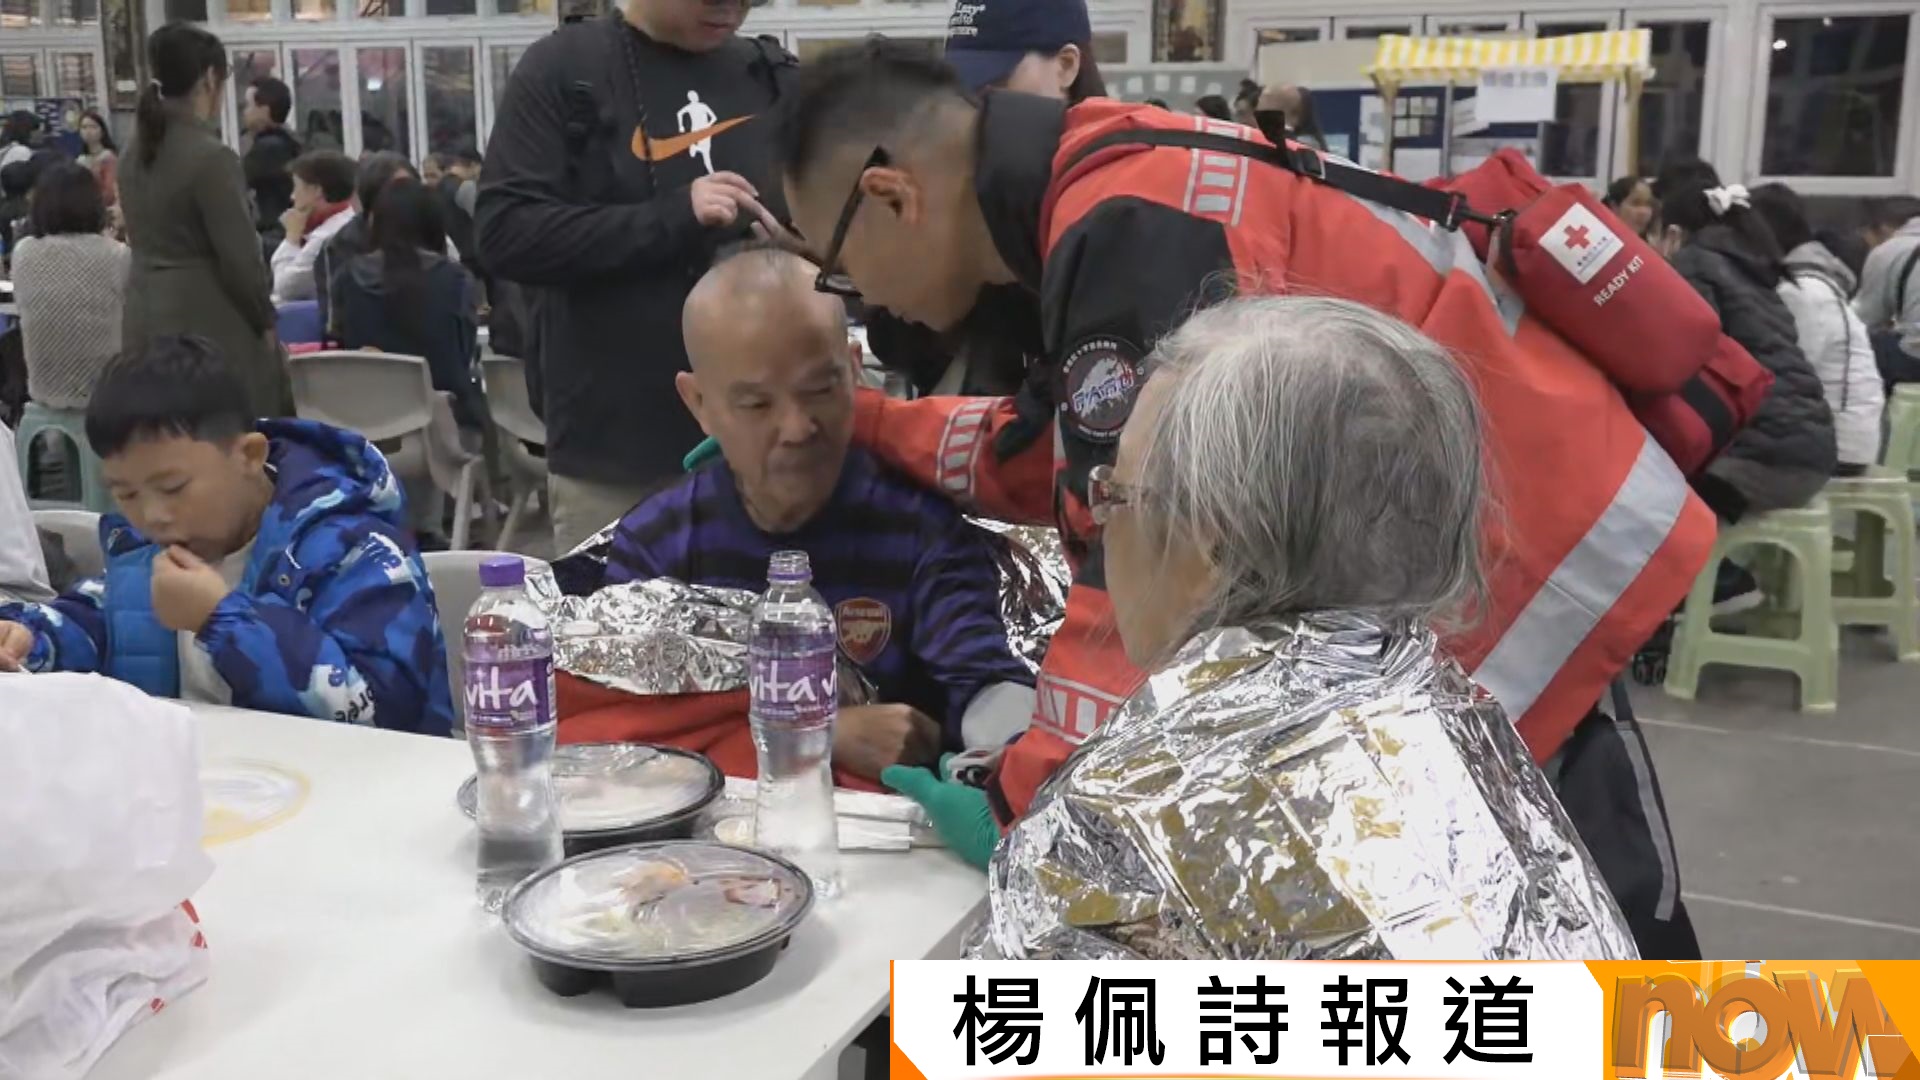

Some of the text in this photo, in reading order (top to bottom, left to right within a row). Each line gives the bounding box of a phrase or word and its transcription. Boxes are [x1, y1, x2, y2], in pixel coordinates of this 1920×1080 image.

[1593, 268, 1629, 307] READY
[463, 665, 538, 709] vita
[749, 660, 816, 703] vita
